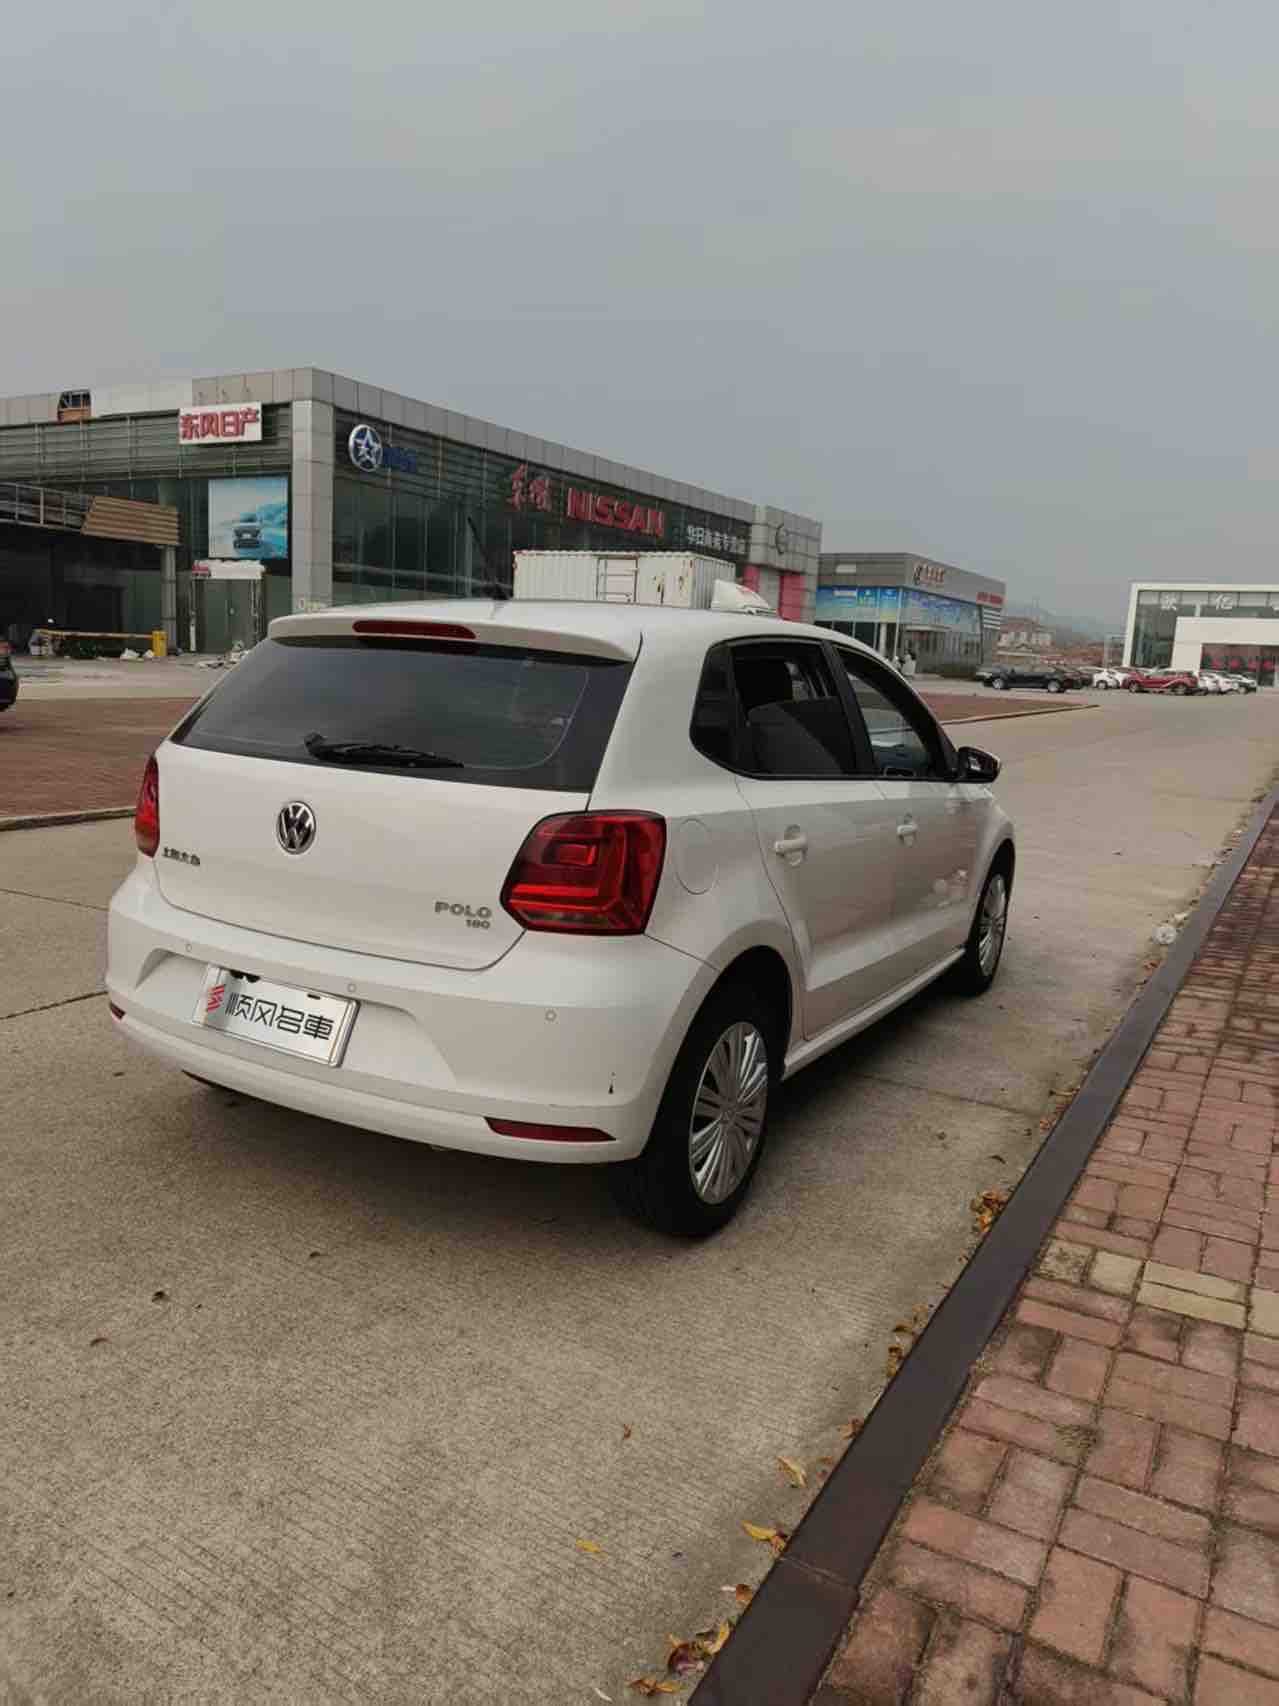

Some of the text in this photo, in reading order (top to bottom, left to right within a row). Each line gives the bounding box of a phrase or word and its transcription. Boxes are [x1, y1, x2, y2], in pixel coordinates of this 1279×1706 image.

[180, 408, 260, 440] 东风日产
[567, 487, 664, 537] NISSAN
[434, 901, 493, 919] POLO
